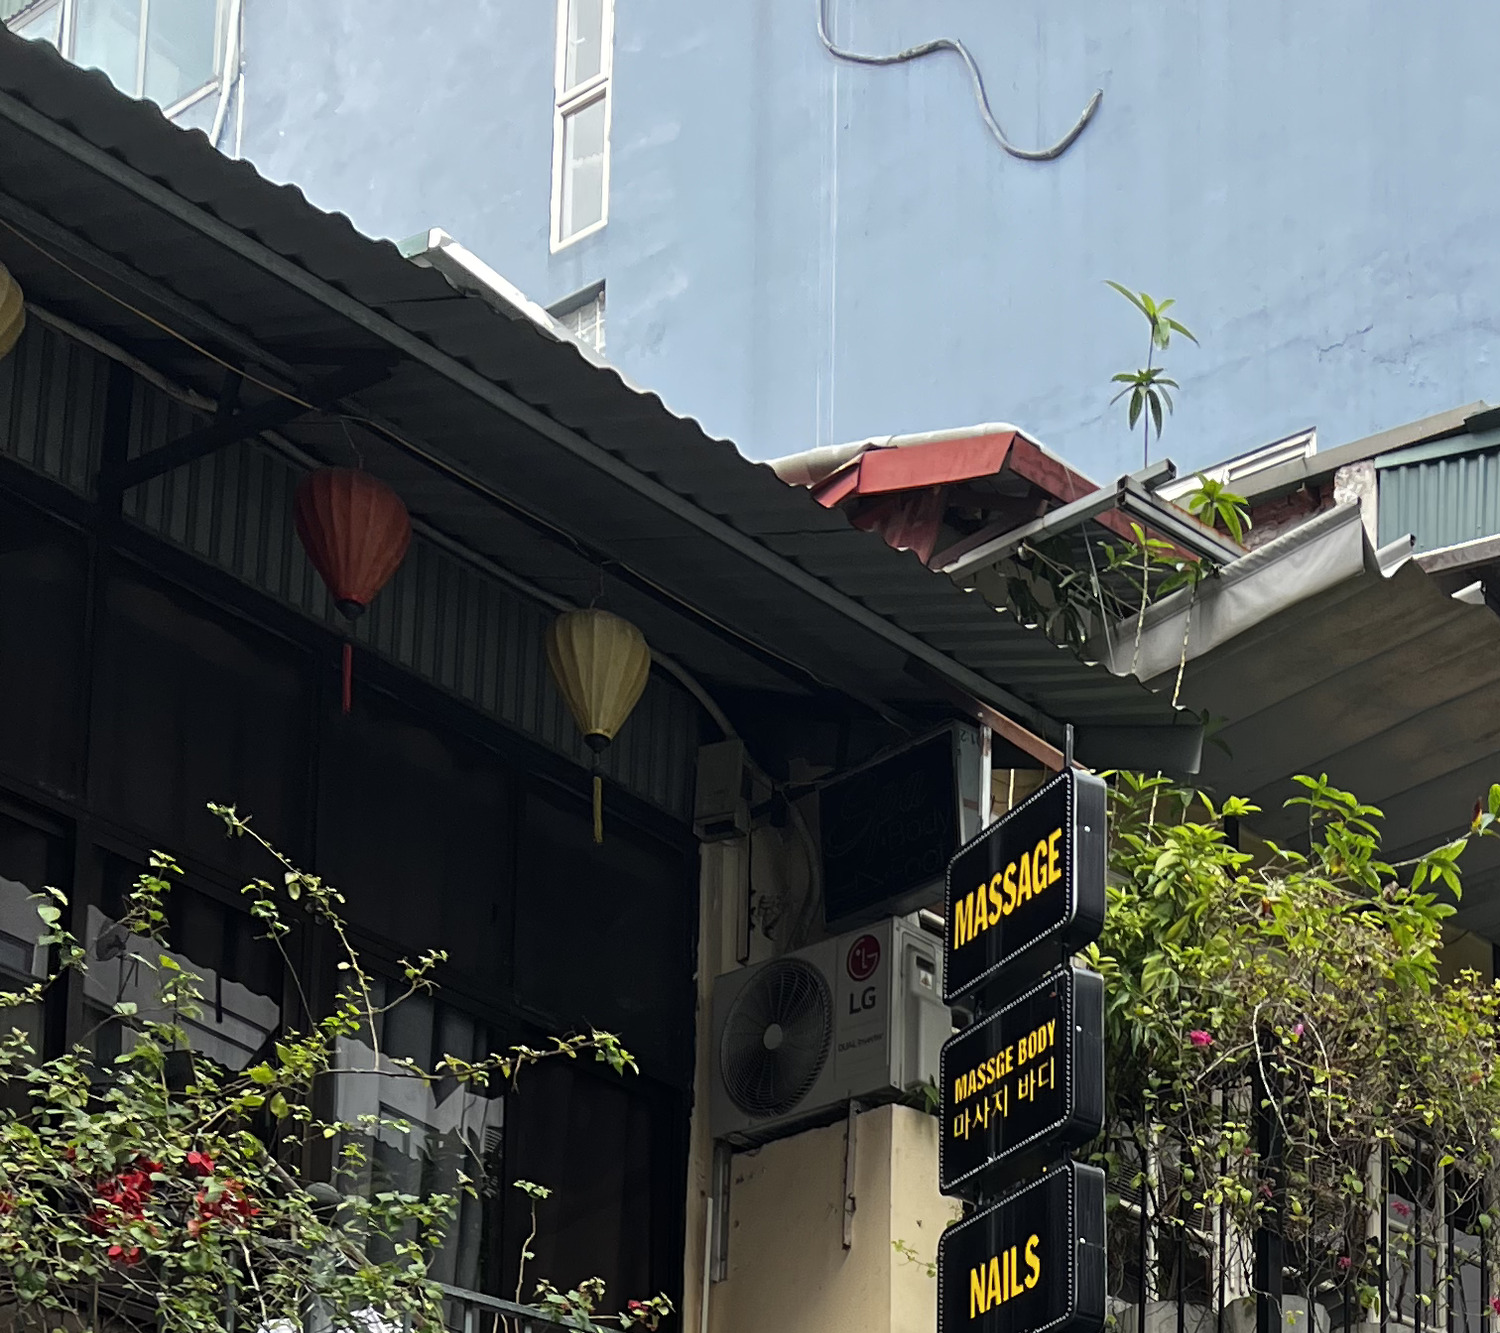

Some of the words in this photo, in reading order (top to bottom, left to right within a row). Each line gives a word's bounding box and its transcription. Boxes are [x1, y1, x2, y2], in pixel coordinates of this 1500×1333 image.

[953, 827, 1063, 951] MASSAGE
[849, 986, 876, 1015] LG
[953, 1090, 1010, 1141] 마사지
[1018, 1056, 1056, 1102] 바디
[954, 1048, 1014, 1103] MASSGE
[1018, 1018, 1057, 1074] BODY
[969, 1233, 1041, 1319] NAILS
